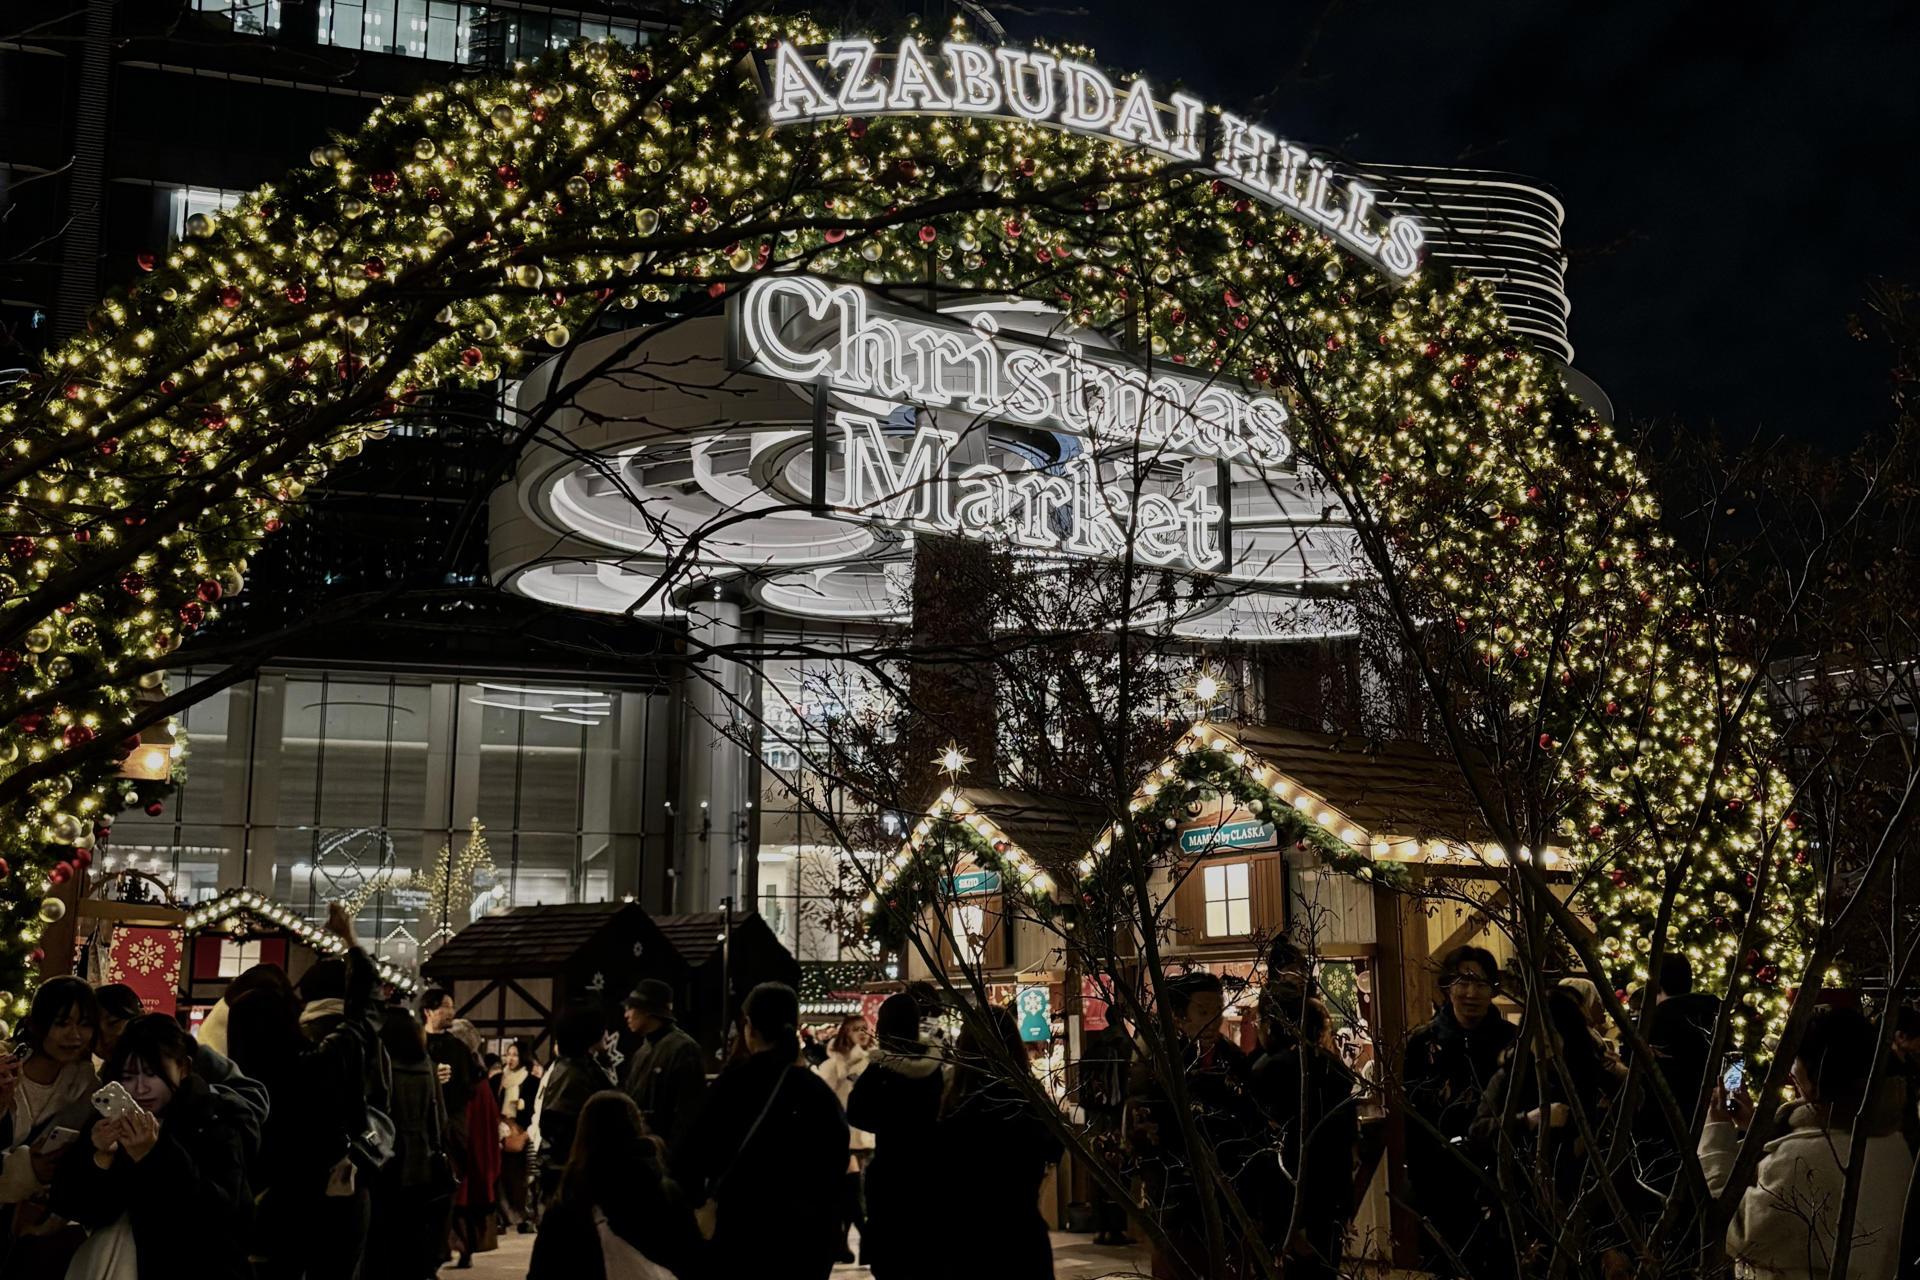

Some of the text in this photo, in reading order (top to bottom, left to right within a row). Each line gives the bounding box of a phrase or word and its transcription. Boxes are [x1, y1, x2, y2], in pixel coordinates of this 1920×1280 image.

[769, 37, 1425, 277] AZABUDAI HILLS
[743, 276, 1293, 466] Christmas
[834, 410, 1224, 570] Market
[1230, 826, 1265, 841] CLASKA
